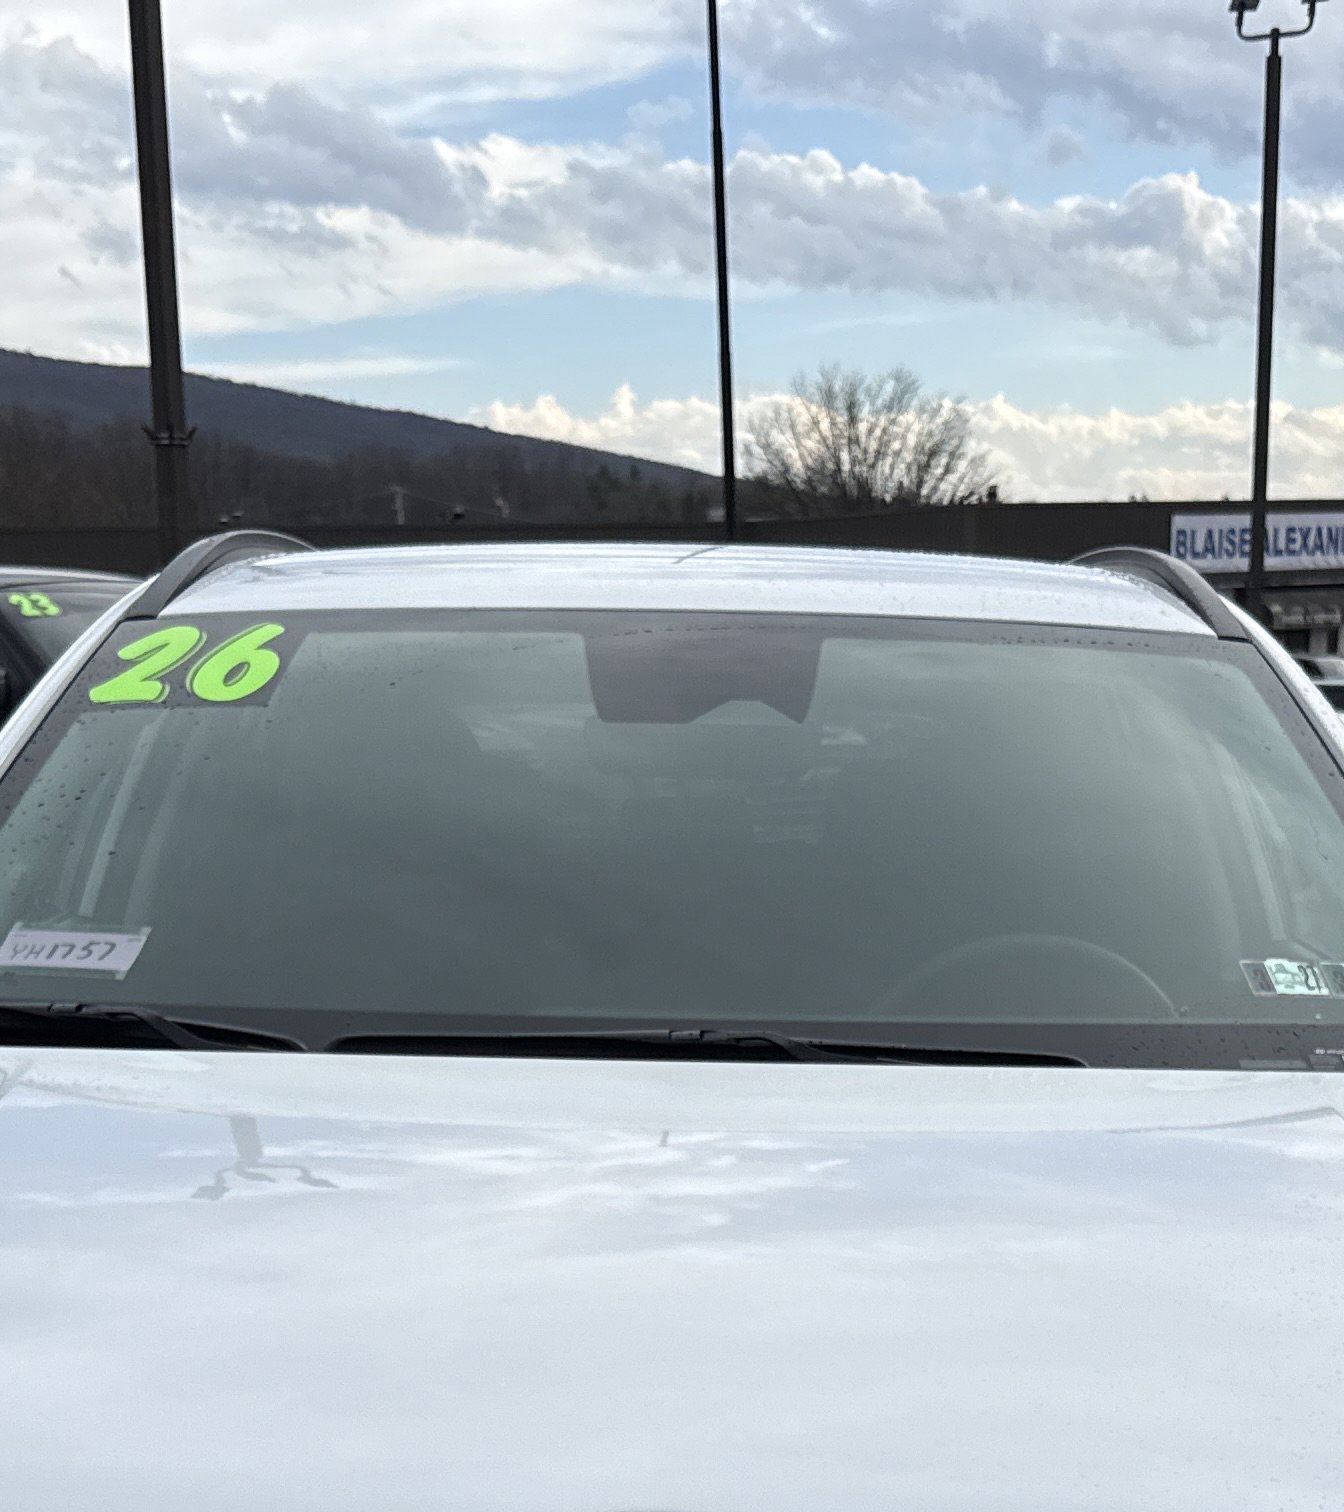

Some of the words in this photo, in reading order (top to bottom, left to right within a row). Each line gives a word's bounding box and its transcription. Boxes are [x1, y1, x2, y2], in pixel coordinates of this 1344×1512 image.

[1175, 527, 1252, 559] BLAISE
[7, 591, 62, 617] 23
[89, 622, 285, 704] 26
